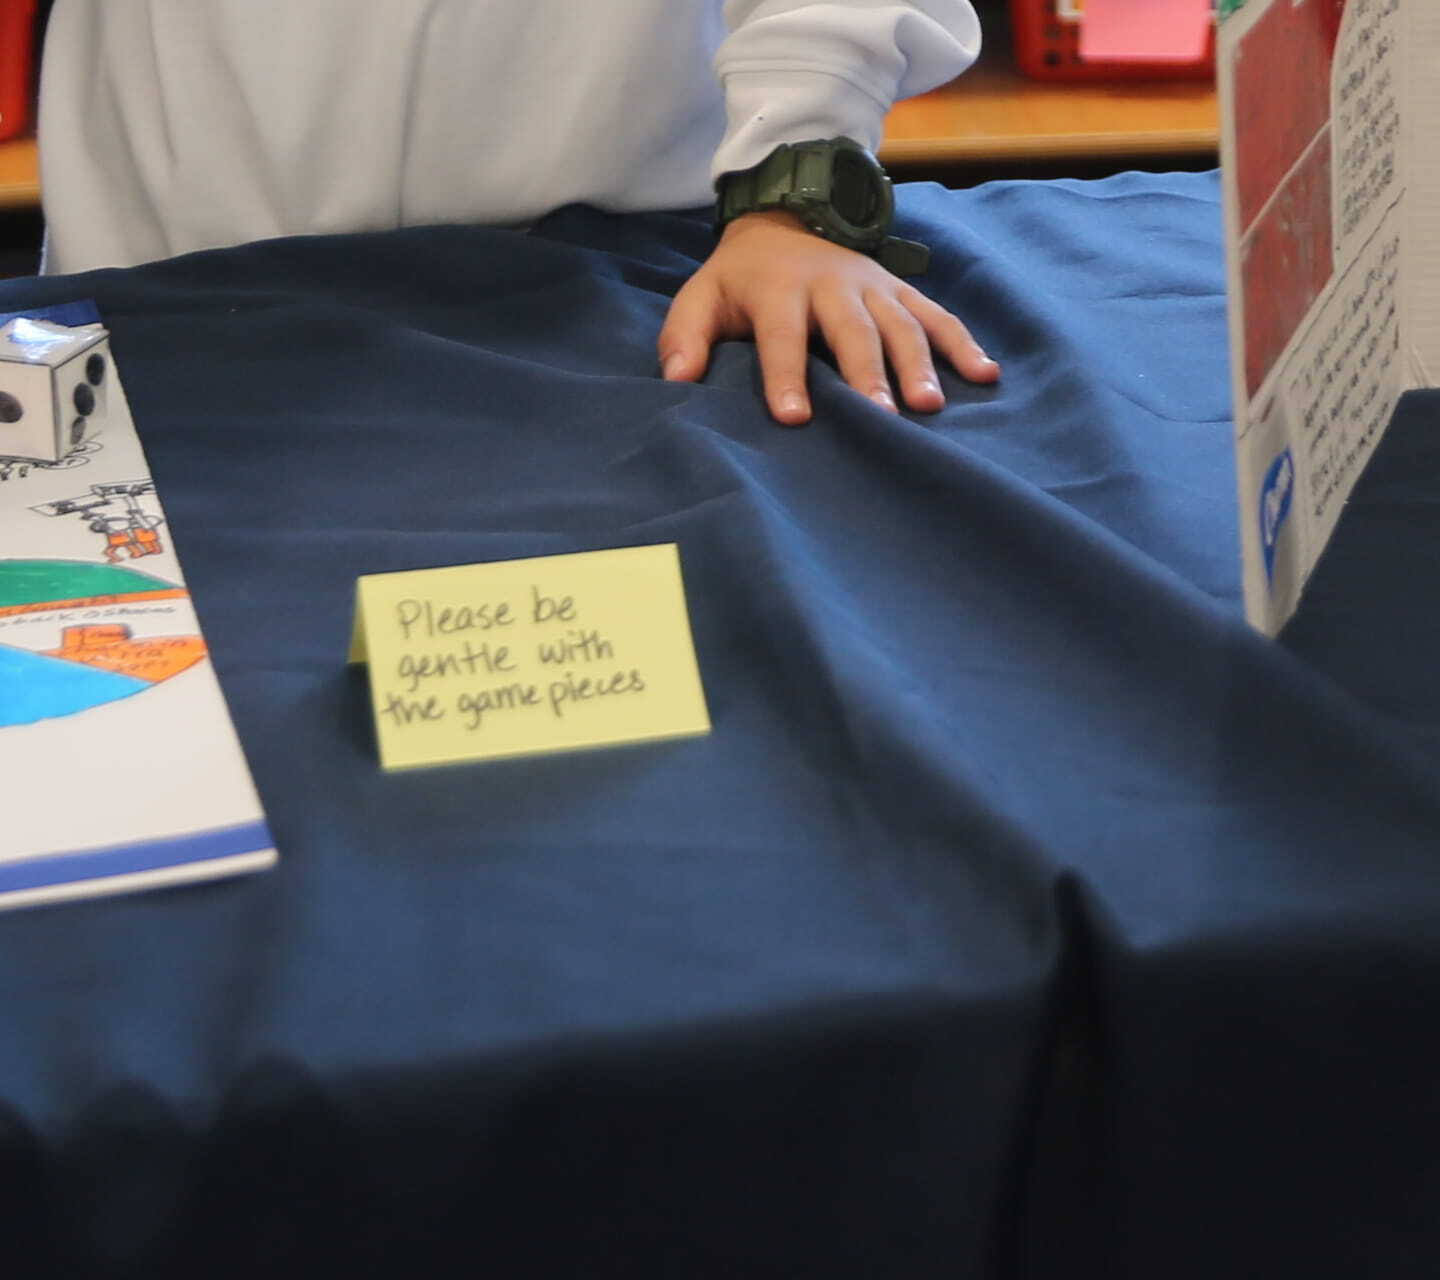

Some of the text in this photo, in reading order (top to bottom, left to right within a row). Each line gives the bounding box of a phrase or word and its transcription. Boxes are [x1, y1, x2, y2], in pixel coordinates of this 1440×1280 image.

[397, 585, 577, 639] Please be
[398, 629, 614, 692] gentle with
[382, 668, 646, 731] the game pieces
